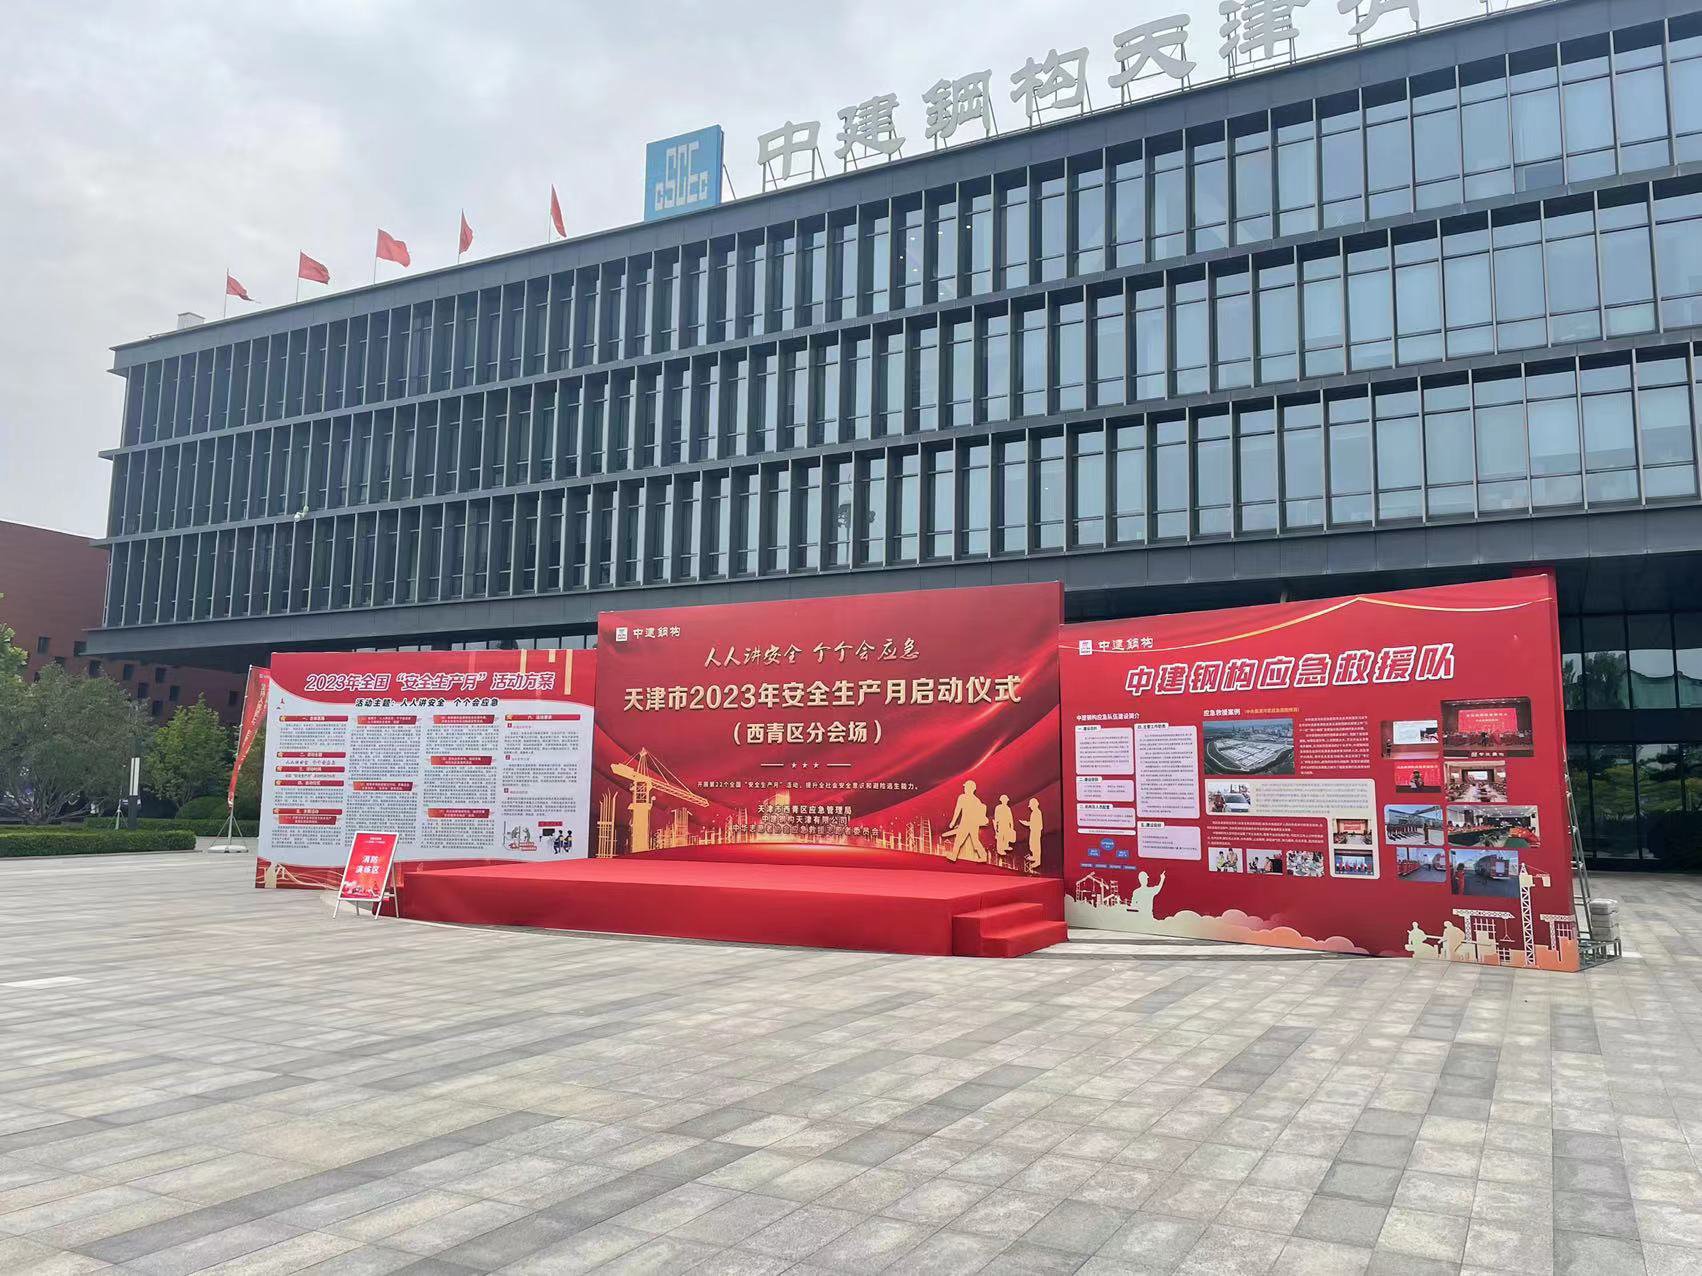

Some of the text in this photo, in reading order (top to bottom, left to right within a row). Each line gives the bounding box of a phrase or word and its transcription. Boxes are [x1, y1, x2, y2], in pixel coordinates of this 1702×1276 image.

[704, 637, 920, 668] 人人讲安全 个个会应急
[1125, 643, 1454, 696] 中建钢构应急救援队
[453, 698, 499, 708] 个个会应急
[623, 674, 1022, 712] 天津市2023年安全生产月启动仪式
[757, 804, 853, 815] 天津市西青区应急管理局
